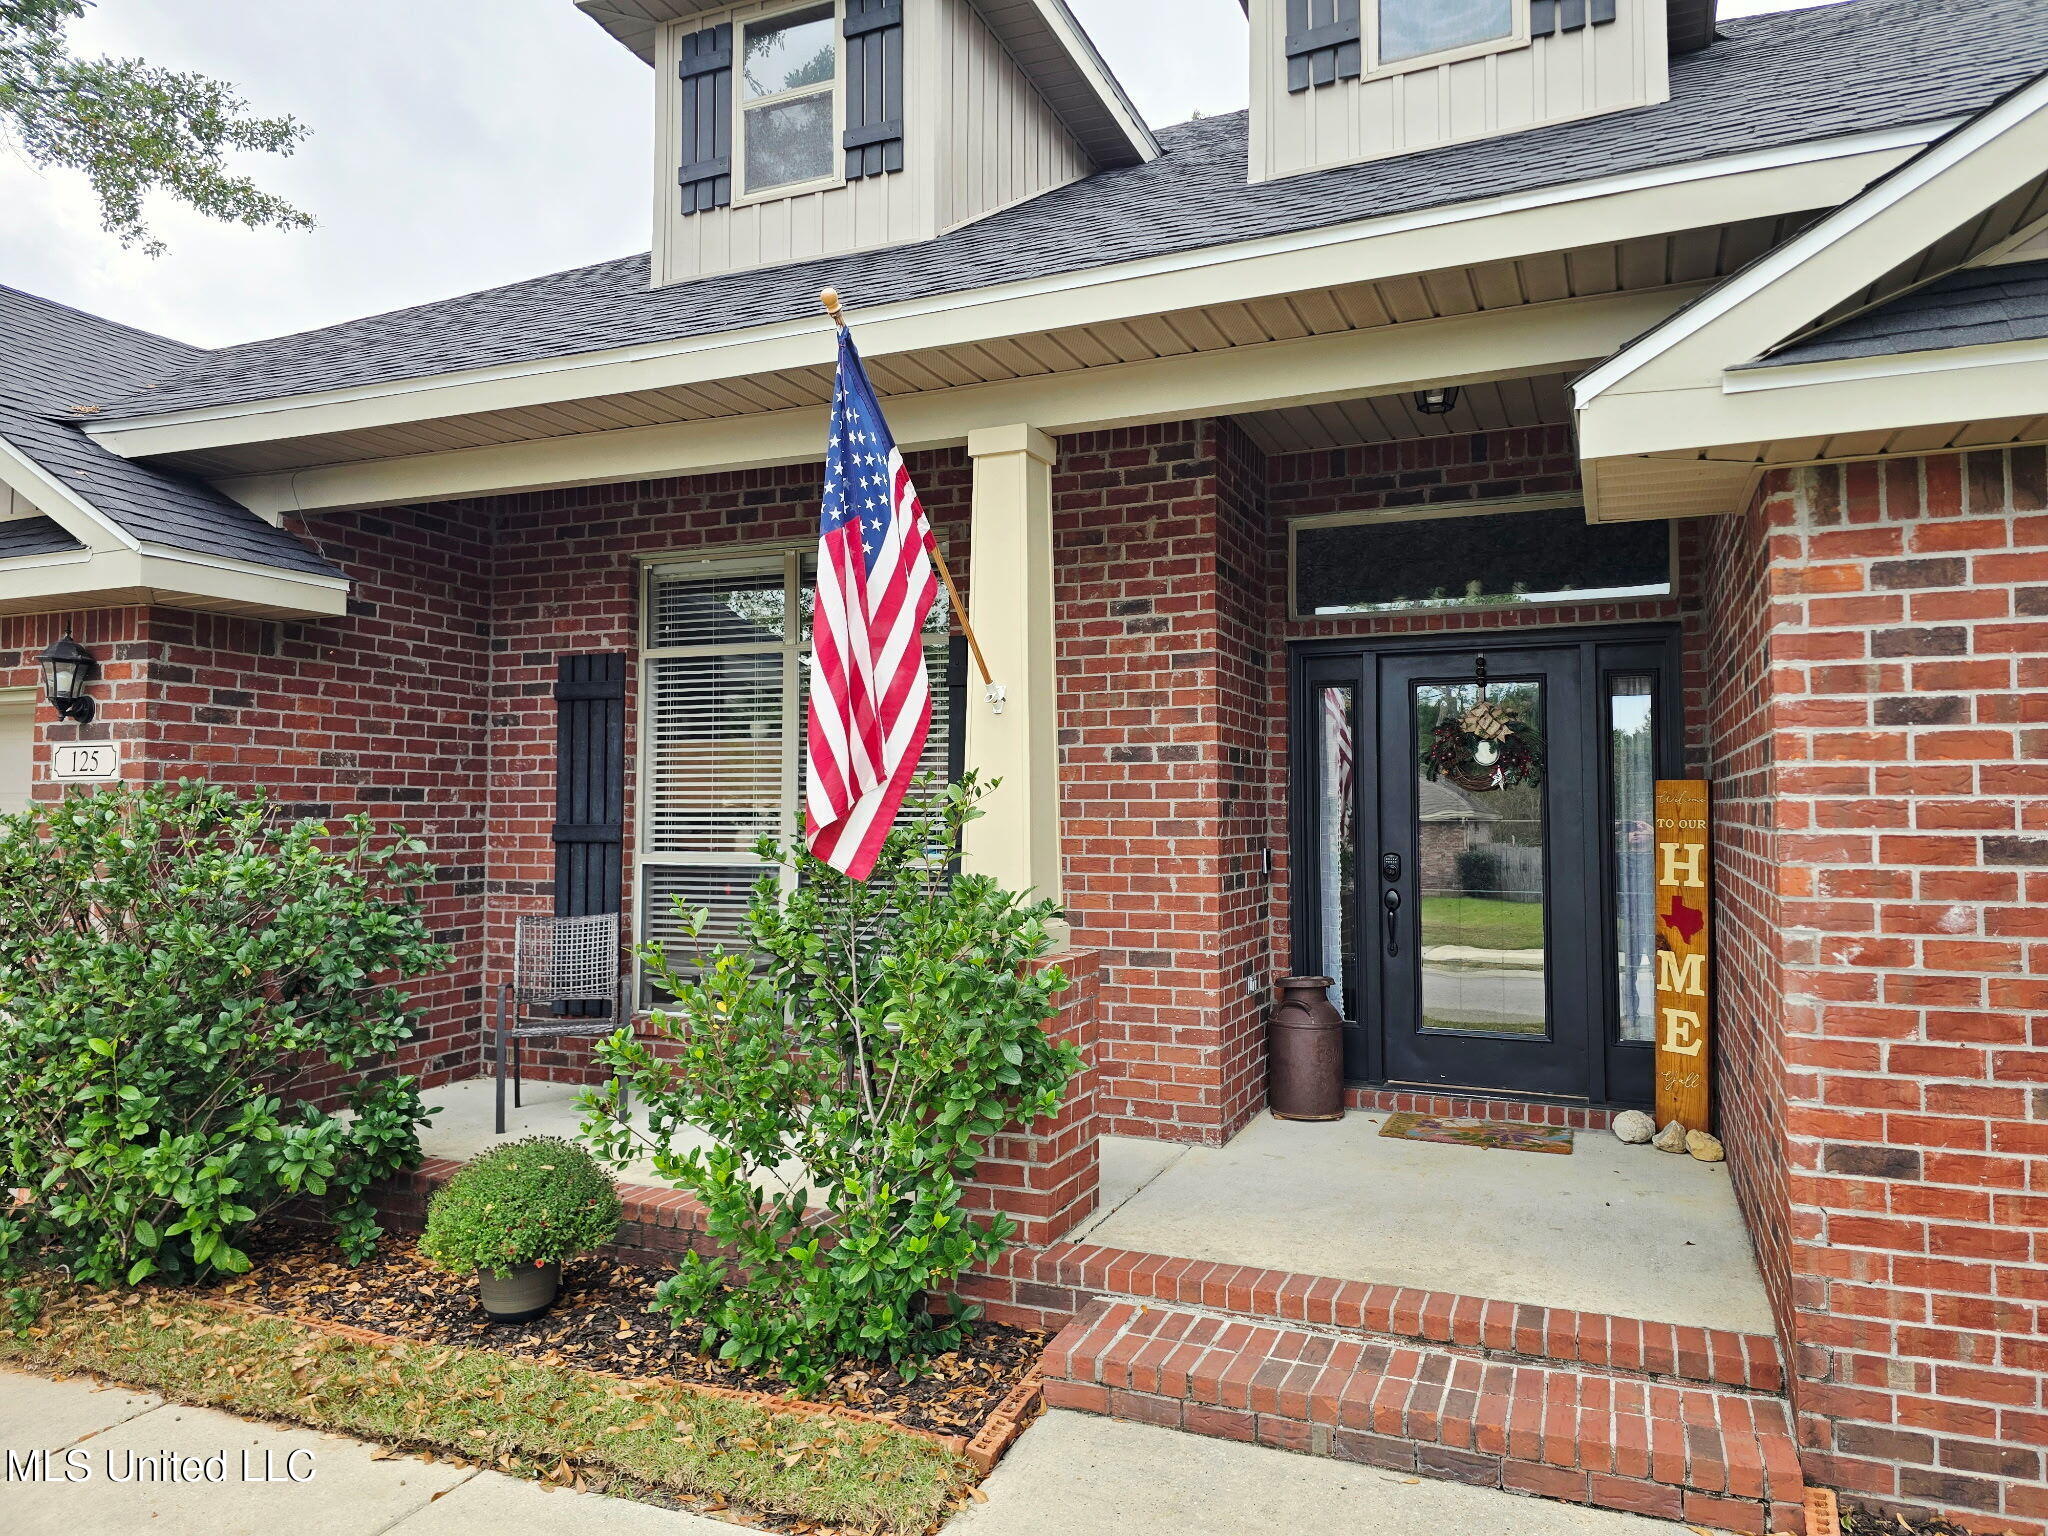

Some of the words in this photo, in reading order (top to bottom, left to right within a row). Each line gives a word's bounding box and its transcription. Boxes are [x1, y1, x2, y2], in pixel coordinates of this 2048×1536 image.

[71, 750, 99, 772] 125
[1656, 818, 1675, 828] TO
[1678, 819, 1706, 829] OUR
